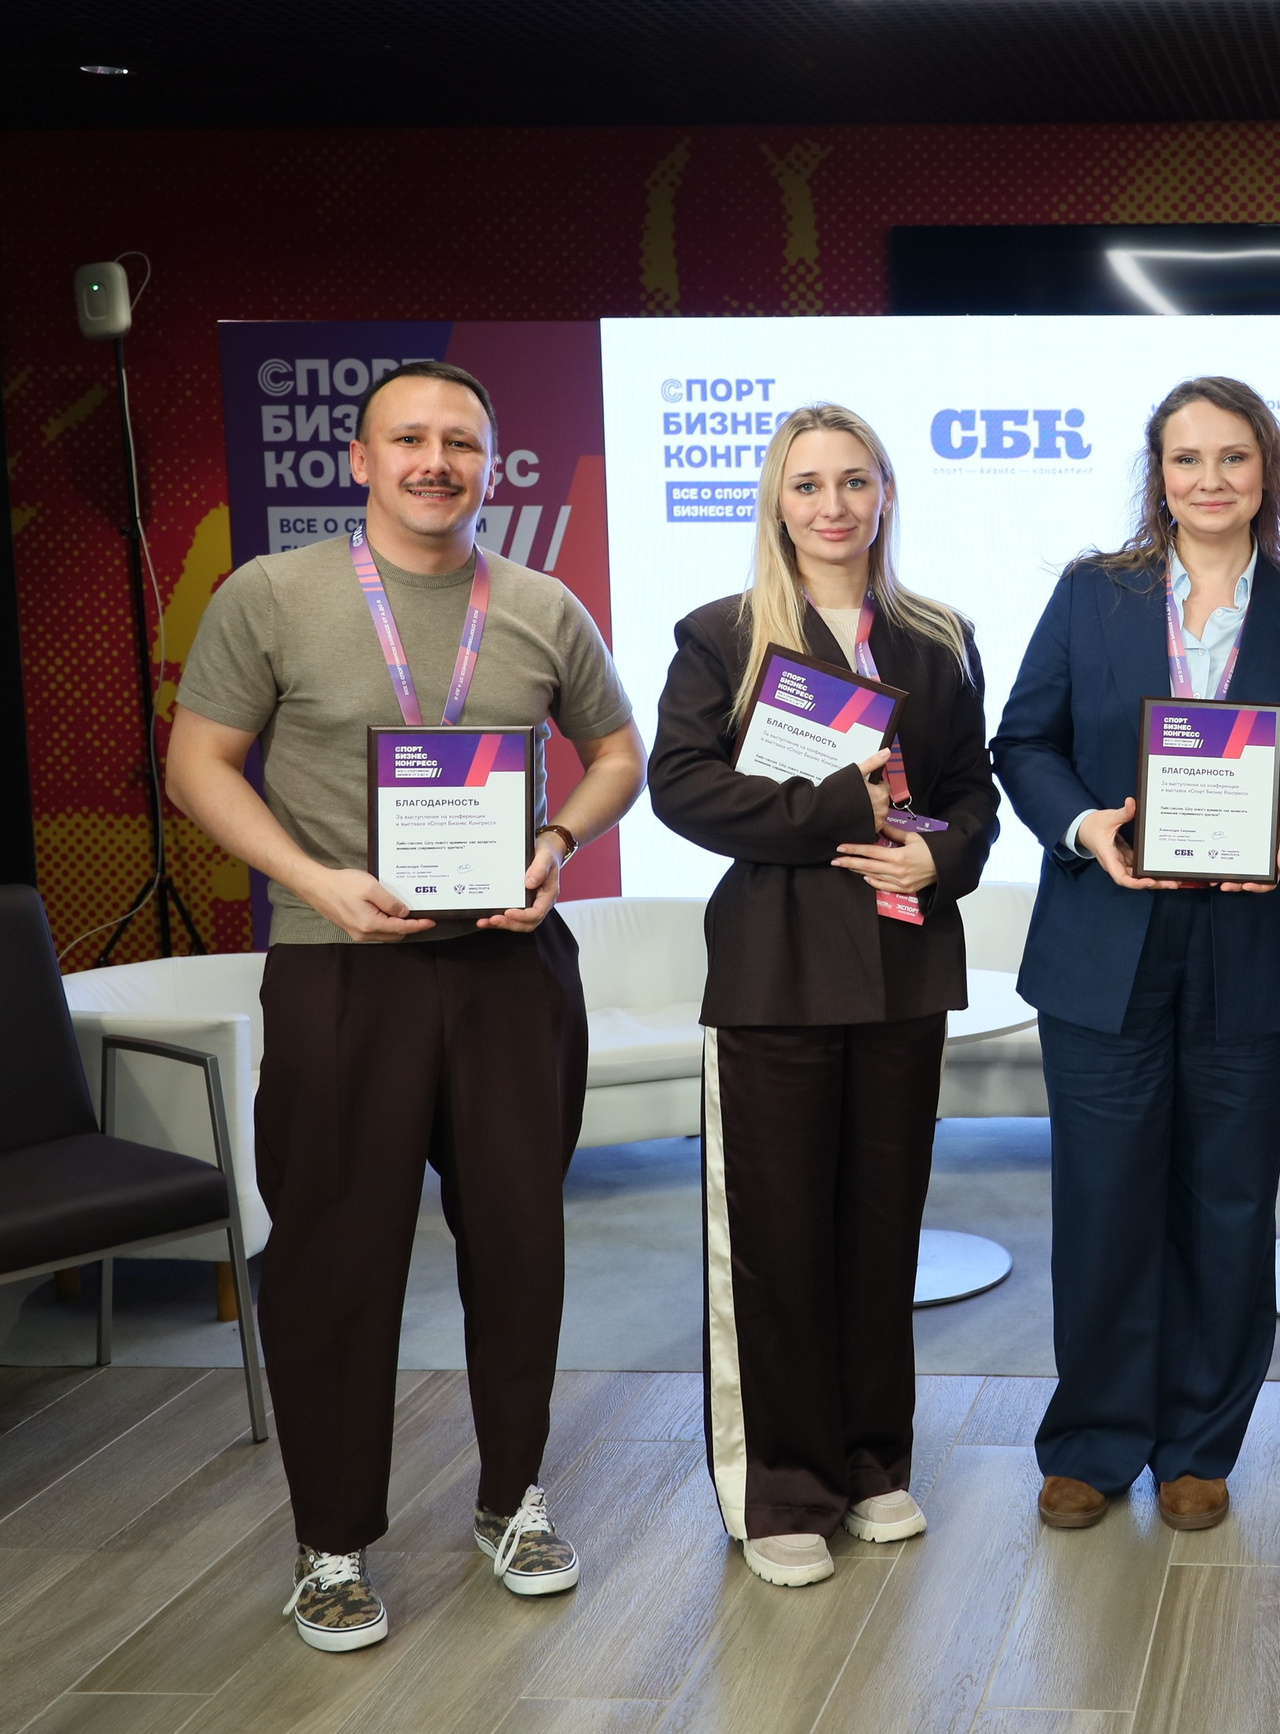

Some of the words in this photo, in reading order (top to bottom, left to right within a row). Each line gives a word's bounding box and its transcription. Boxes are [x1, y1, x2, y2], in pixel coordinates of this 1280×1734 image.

[661, 378, 776, 403] СПОРТ
[261, 404, 360, 442] БИЗ
[930, 408, 1093, 460] СБК
[664, 444, 769, 469] КОНГР
[1032, 468, 1093, 476] КОНСАЛТИНГ
[672, 488, 699, 500] ВСЕ
[700, 488, 712, 500] О
[673, 505, 734, 517] БИЗНЕСЕ
[736, 505, 754, 517] ОТ
[280, 518, 318, 534] ВСЕ
[324, 518, 338, 534] О
[779, 676, 807, 691] БИЗНЕС
[781, 670, 806, 684] СПОРТ
[777, 682, 814, 701] КОНГРЕСС
[765, 716, 838, 750] БЛАГОДАРНОСТЬ
[1161, 766, 1234, 778] БЛАГОДАРНОСТЬ
[395, 798, 479, 807] БЛАГОДАРНОСТЬ
[1174, 848, 1193, 856] СБК
[414, 885, 437, 893] СБК
